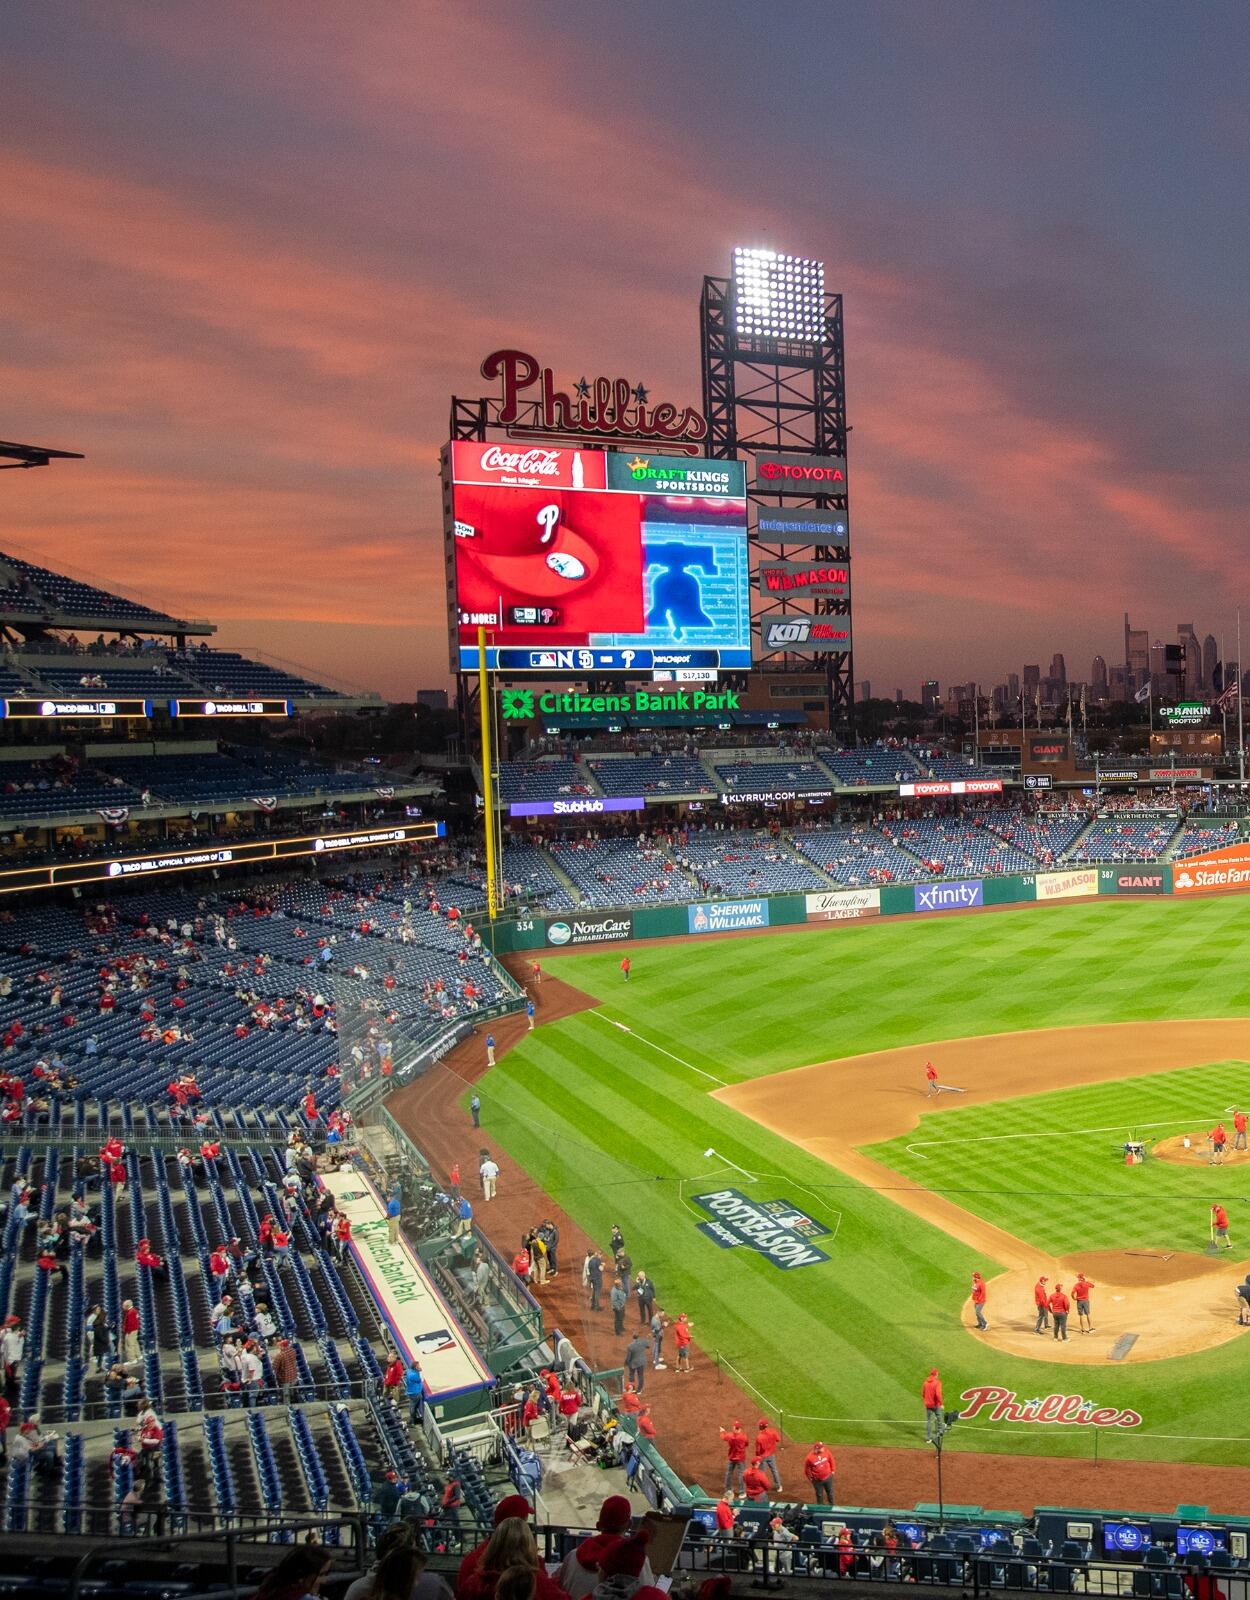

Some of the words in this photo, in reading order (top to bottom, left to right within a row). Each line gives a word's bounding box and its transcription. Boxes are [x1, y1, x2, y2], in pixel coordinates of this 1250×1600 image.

[480, 349, 708, 440] Phillies
[782, 465, 844, 481] TOYOTA
[656, 480, 729, 494] SPORTSBOOK
[471, 613, 497, 625] MORE!
[539, 693, 631, 713] Citizens
[636, 690, 691, 711] Bank
[693, 689, 740, 710] Park
[1159, 707, 1174, 716] CP
[1033, 745, 1065, 753] GIANT
[916, 784, 950, 793] TOYOTA
[967, 782, 999, 791] TOYOTA
[729, 791, 795, 803] KLYRRUM.COM
[553, 800, 604, 814] StubHub
[1022, 876, 1034, 886] 374
[1101, 871, 1114, 879] 387
[1118, 876, 1163, 887] GIANT
[816, 892, 871, 912] Yuengling
[918, 884, 979, 909] xfinity
[709, 903, 761, 917] SHERWIN
[827, 909, 860, 920] LAGER
[516, 921, 534, 932] 334
[573, 932, 628, 943] REHABILITATION
[699, 1190, 821, 1267] POSTSEASON
[379, 1261, 414, 1285] Bank
[390, 1281, 425, 1304] Park
[958, 1386, 1142, 1427] Phillies
[1191, 1537, 1210, 1545] NLCS
